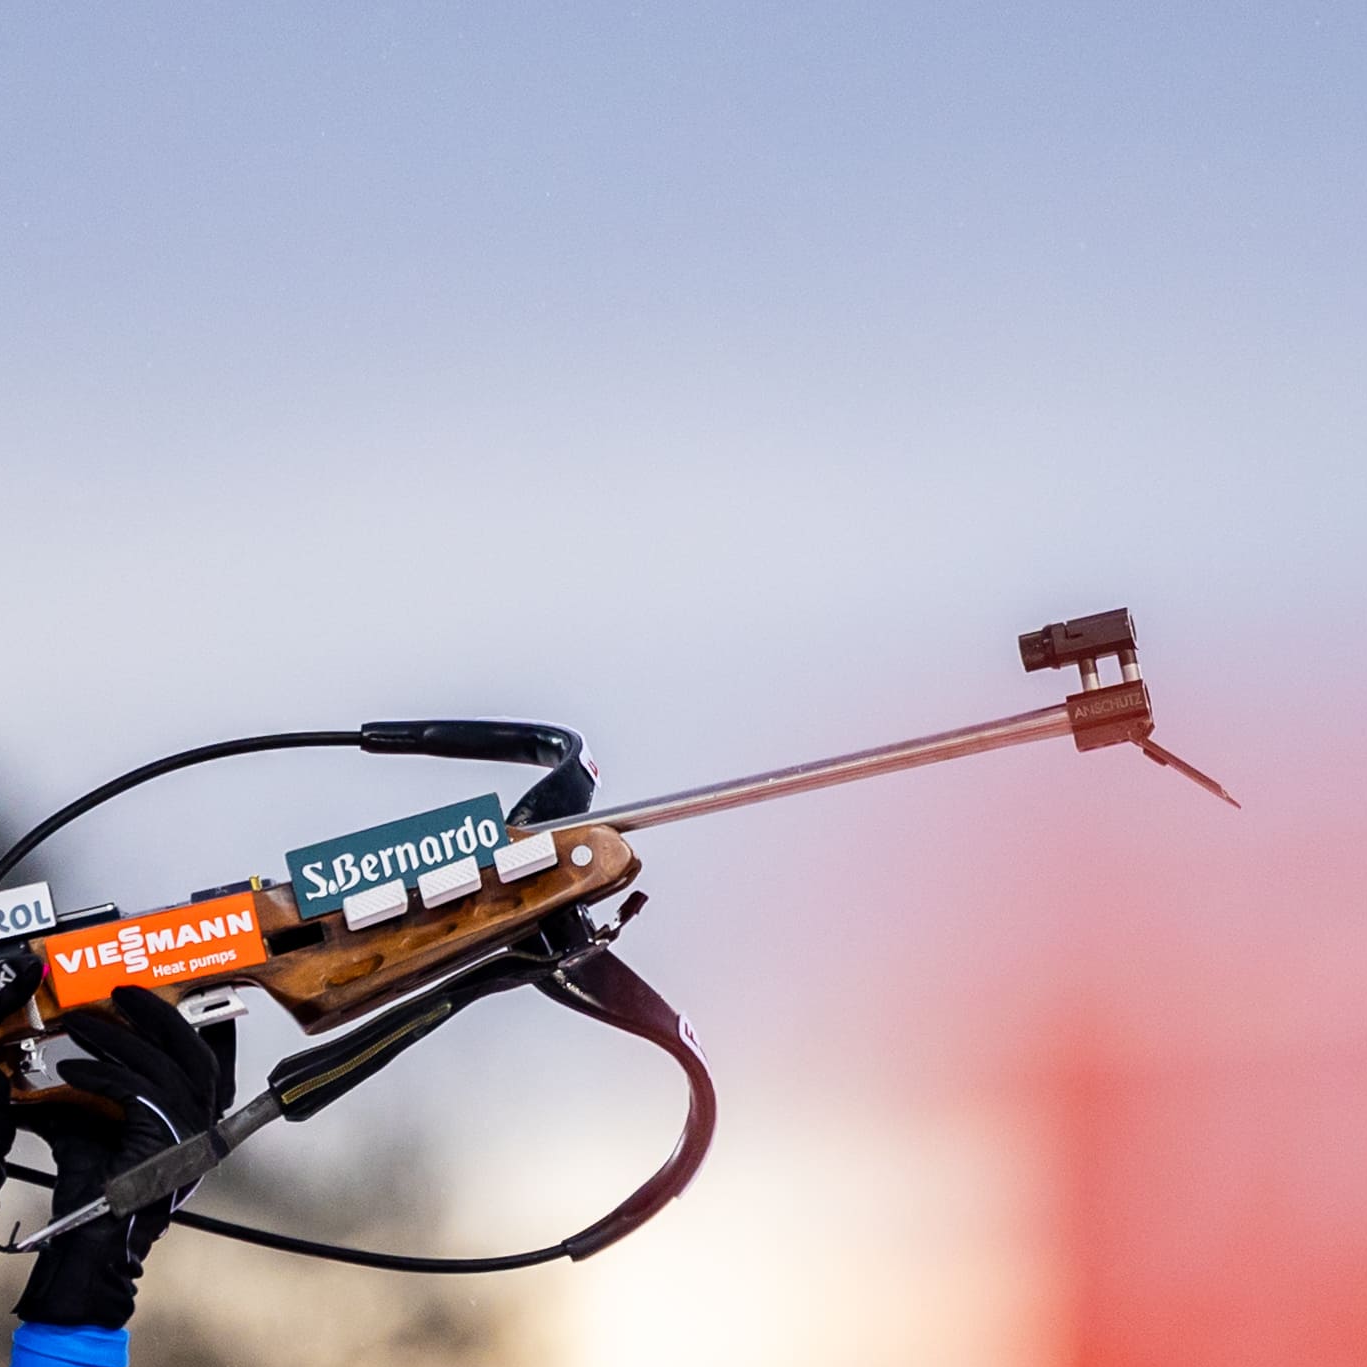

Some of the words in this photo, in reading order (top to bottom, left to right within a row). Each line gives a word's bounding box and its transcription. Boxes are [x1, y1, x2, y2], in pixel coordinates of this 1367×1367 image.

[301, 815, 500, 901] S.Bernardo
[54, 909, 255, 975] VIESSMANN
[153, 957, 186, 979] Heat
[189, 948, 238, 974] pumps
